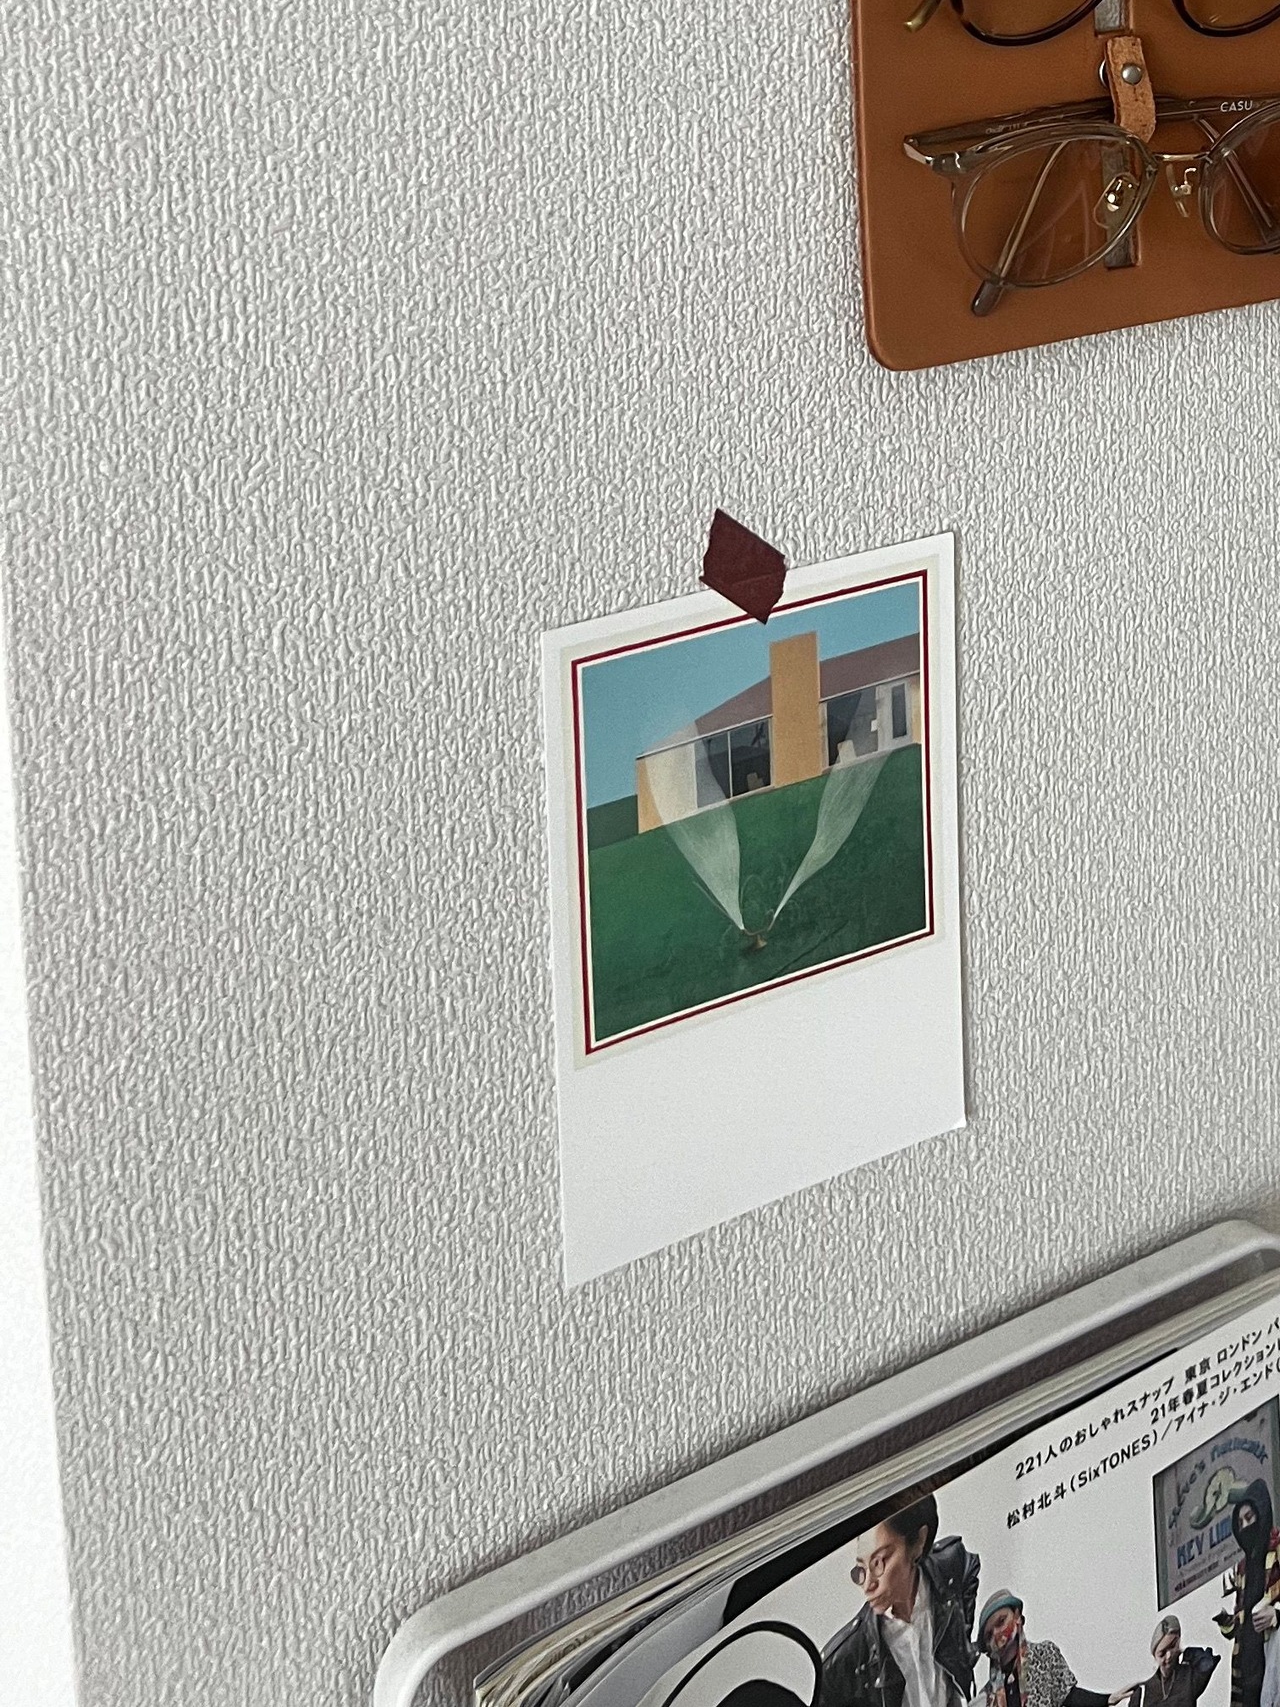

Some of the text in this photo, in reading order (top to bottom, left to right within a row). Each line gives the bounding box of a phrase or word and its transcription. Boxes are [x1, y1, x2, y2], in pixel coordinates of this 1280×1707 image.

[1220, 100, 1253, 113] CASU
[1015, 1376, 1175, 1481] 221人のおしゃれスナップ
[1184, 1355, 1212, 1385] 東京
[1216, 1329, 1262, 1364] ロンドン
